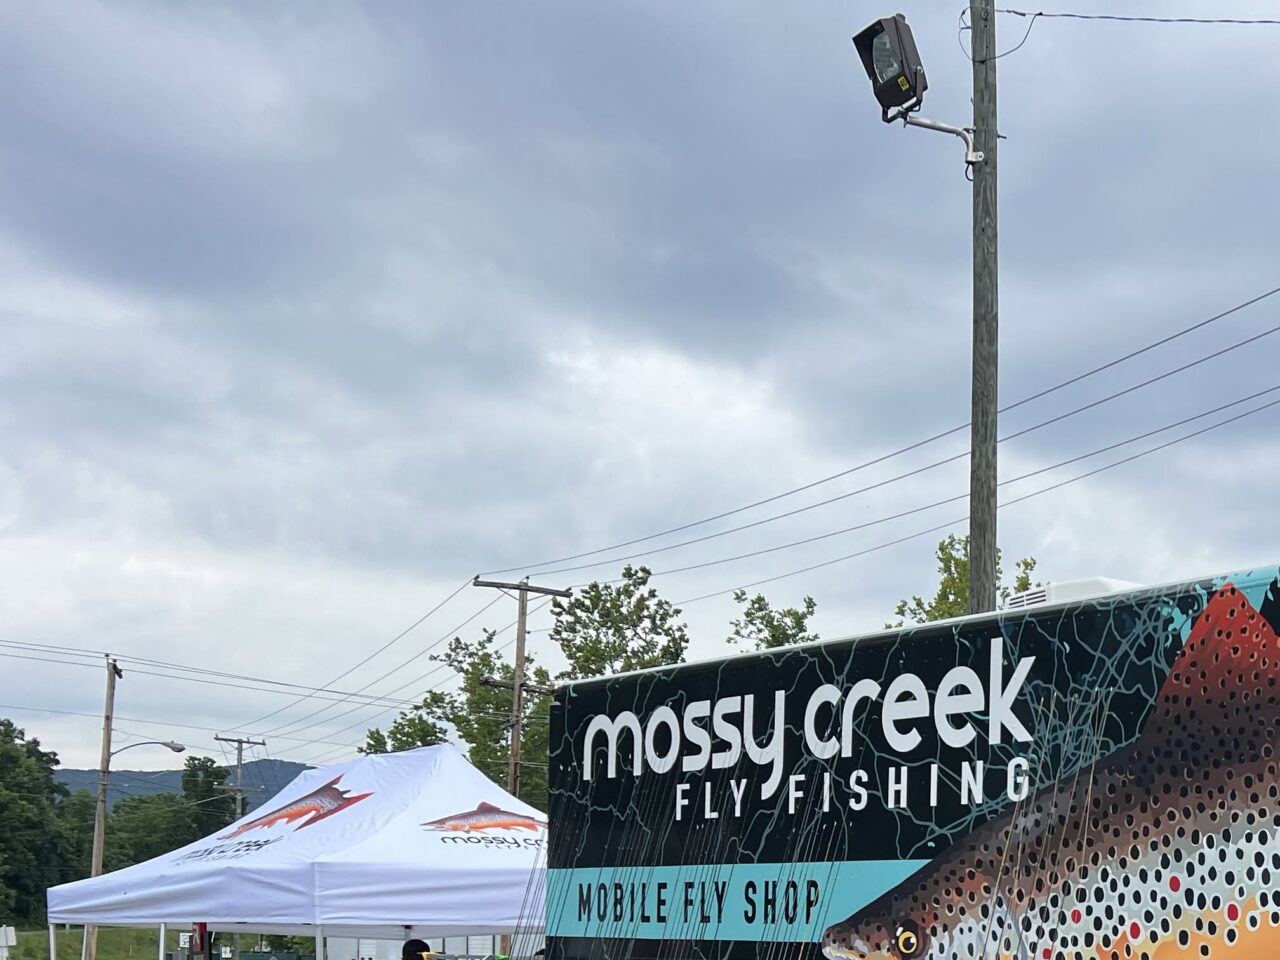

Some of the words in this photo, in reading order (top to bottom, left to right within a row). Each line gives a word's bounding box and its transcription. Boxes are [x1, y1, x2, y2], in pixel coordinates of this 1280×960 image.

[583, 690, 785, 800] mossy
[804, 637, 1036, 759] creek
[675, 778, 747, 821] FLY
[788, 757, 1030, 815] FISHING
[440, 836, 521, 848] mossy
[578, 882, 668, 923] MOBILE
[683, 881, 727, 923] FLY
[743, 880, 820, 924] SHOP
